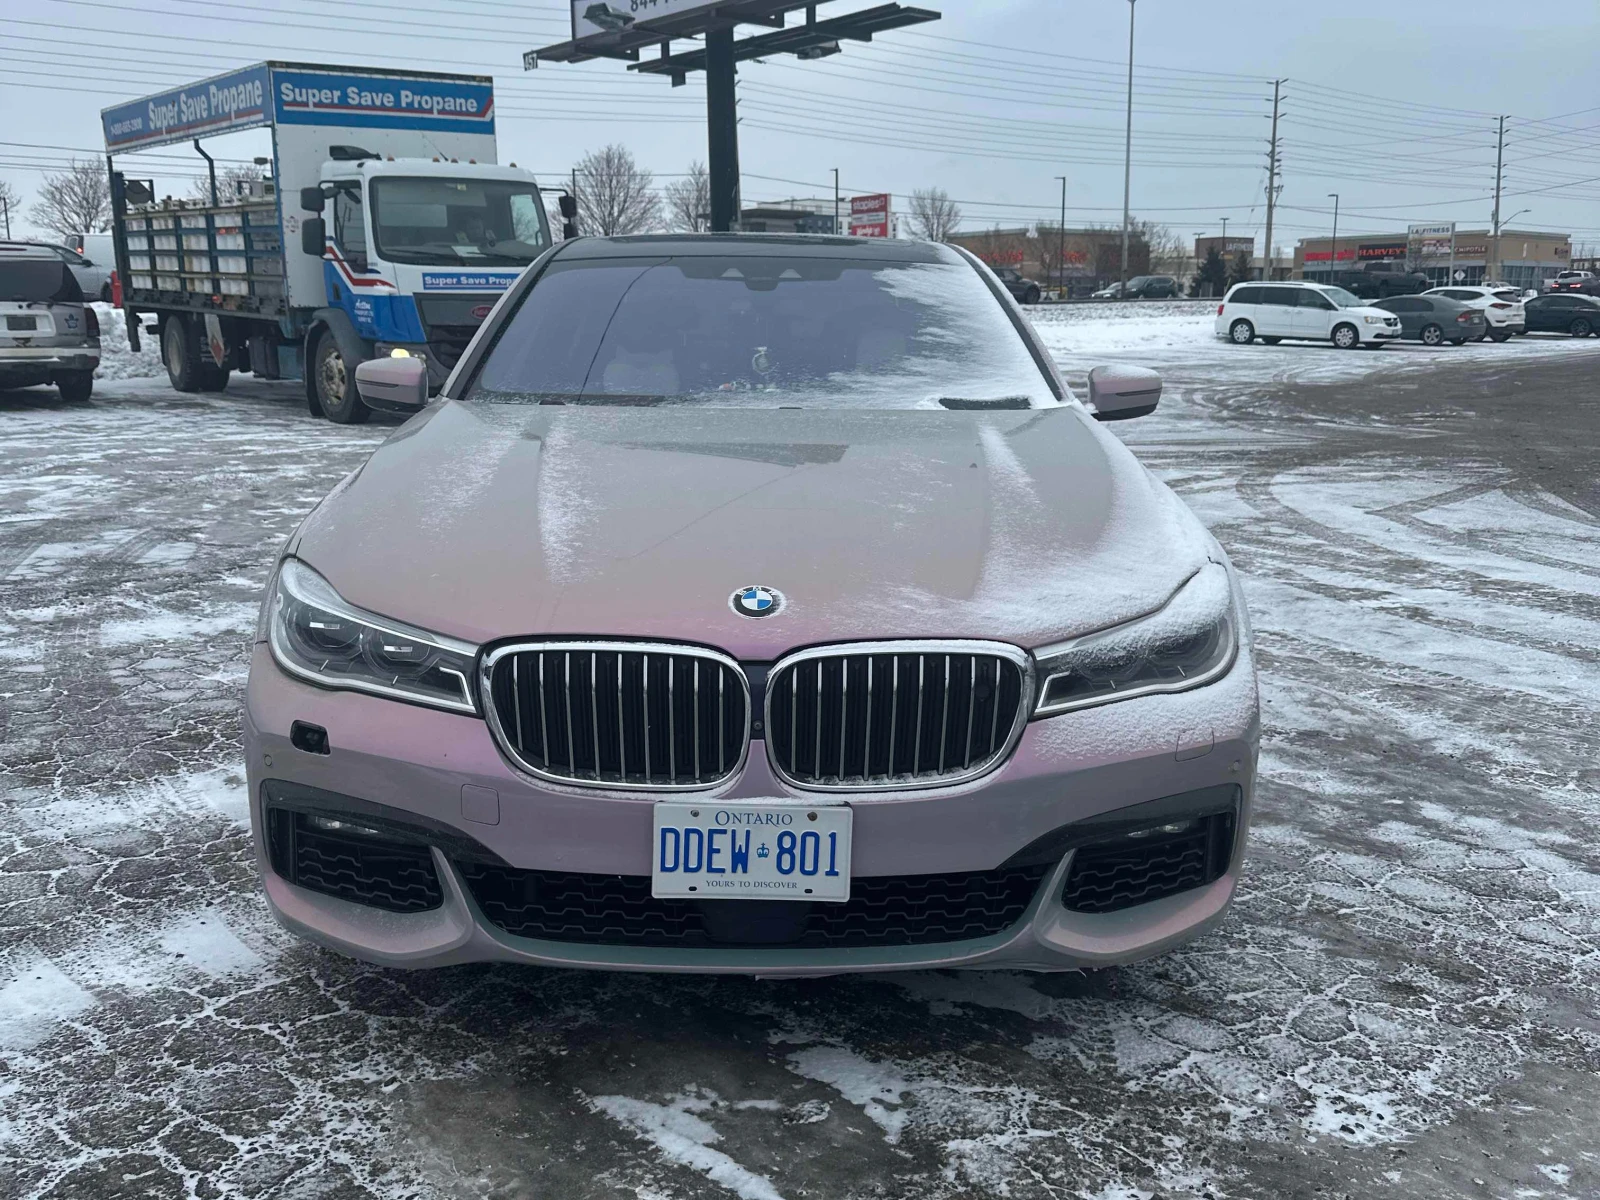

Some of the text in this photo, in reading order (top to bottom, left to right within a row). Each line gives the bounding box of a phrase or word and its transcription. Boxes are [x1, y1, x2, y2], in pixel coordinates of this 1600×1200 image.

[148, 79, 263, 135] Super Save Propane
[281, 82, 478, 115] Super Save Propane
[1422, 226, 1450, 234] FITNESS
[424, 276, 457, 287] Super
[460, 276, 486, 285] Save
[660, 828, 839, 876] DDEW 801
[706, 880, 735, 888] YOURS
[753, 881, 798, 889] DISCOVER
